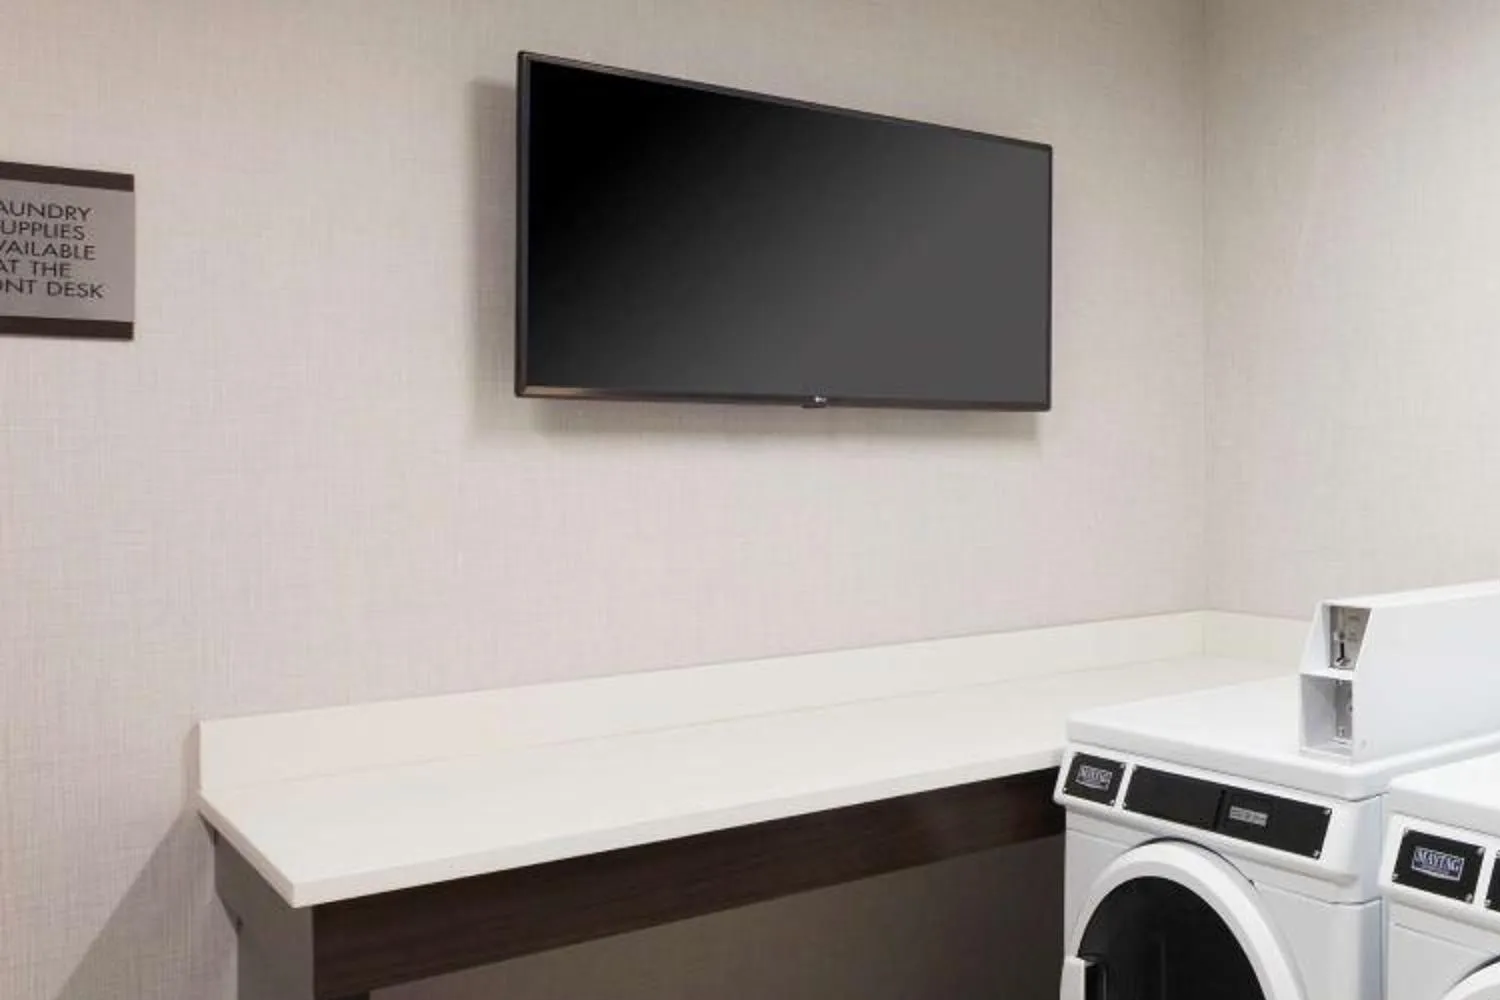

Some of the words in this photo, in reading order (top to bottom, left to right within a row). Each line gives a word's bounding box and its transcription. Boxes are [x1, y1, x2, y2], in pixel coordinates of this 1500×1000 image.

[0, 201, 91, 221] AUNDRY
[0, 219, 85, 241] UPPLIES
[30, 259, 71, 278] THE
[0, 277, 37, 295] NT
[47, 281, 104, 299] DESK
